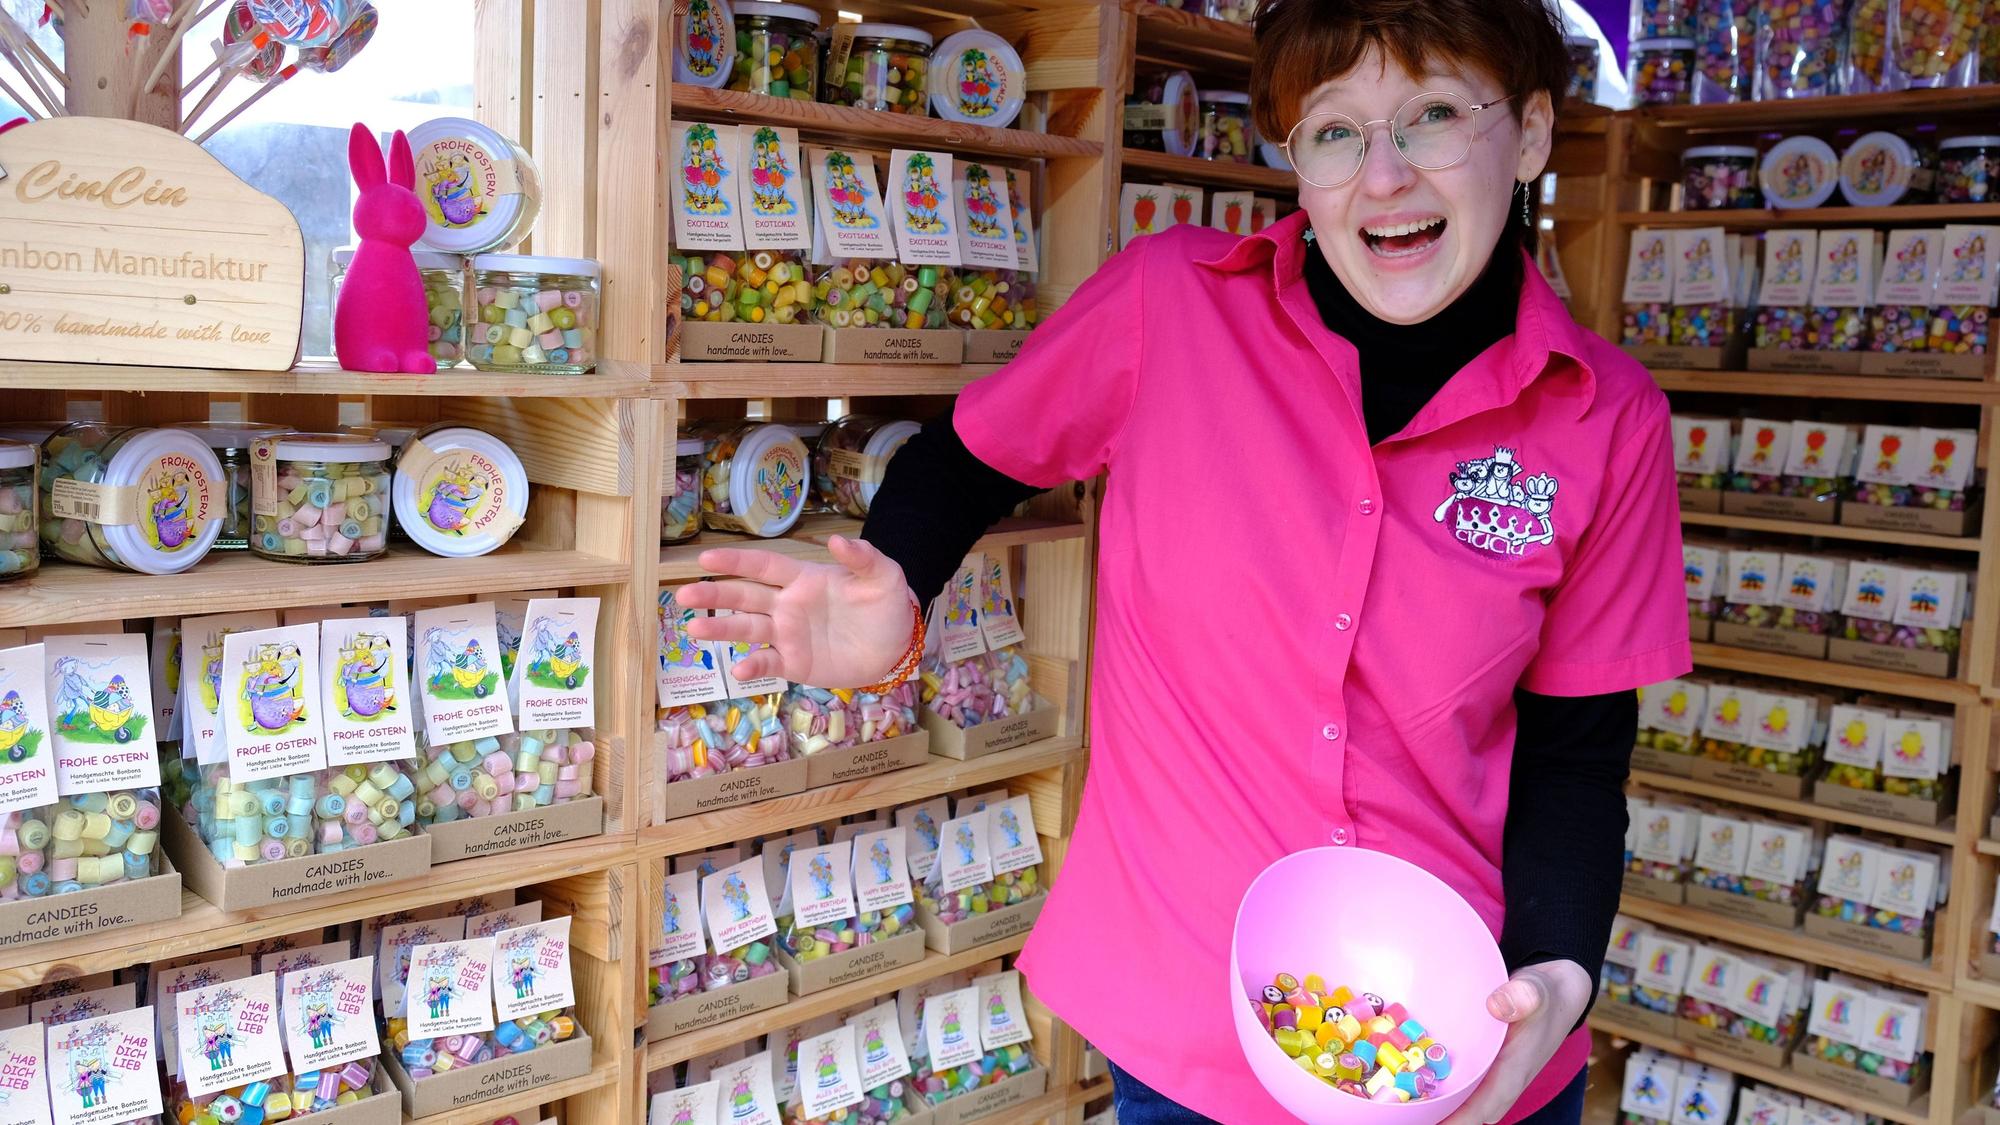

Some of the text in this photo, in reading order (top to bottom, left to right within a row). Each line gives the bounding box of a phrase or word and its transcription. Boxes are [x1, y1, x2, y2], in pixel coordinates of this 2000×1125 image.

[434, 140, 496, 198] FROHE OSTERN
[16, 160, 189, 209] CinCin
[687, 219, 729, 229] EXOTICMIX
[755, 220, 796, 228] EXOTICMIX
[909, 238, 948, 247] EXOTICMIX
[94, 247, 268, 282] Manufaktur
[54, 313, 168, 340] handmade
[177, 320, 222, 341] with
[231, 325, 272, 344] love
[731, 333, 774, 344] CANDIES
[885, 338, 921, 348] CANDIES
[706, 345, 749, 356] handmade
[751, 346, 770, 356] with
[863, 350, 901, 360] handmade
[902, 350, 918, 359] with
[161, 456, 209, 521] FROHE OSTERN
[470, 454, 503, 529] FROHE OSTERN
[526, 697, 588, 708] FROHE OSTERN
[433, 704, 503, 723] FROHE OSTERN
[333, 726, 407, 741] FROHE OSTERN
[236, 737, 317, 758] FROHE OSTERN
[59, 752, 149, 768] FROHE OSTERN
[246, 756, 287, 768] Handgemachte
[852, 750, 888, 764] CANDIES
[70, 771, 115, 780] Handgemachte
[832, 766, 869, 779] handmade
[870, 762, 886, 772] with
[720, 777, 761, 792] CANDIES
[697, 794, 739, 808] handmade
[740, 790, 757, 800] with
[494, 819, 544, 836] CANDIES
[464, 838, 517, 854] handmade
[519, 832, 541, 844] with
[305, 859, 365, 878] CANDIES
[272, 879, 335, 898] handmade
[336, 874, 361, 887] with
[27, 903, 98, 925] CANDIES
[64, 919, 93, 934] with
[546, 938, 564, 950] HAB
[665, 933, 697, 944] BIRTHDAY
[540, 947, 563, 959] DICH
[848, 951, 885, 968] CANDIES
[468, 959, 487, 972] HAB
[537, 957, 559, 969] LIEB
[460, 968, 485, 983] DICH
[829, 967, 865, 984] handmade
[867, 963, 882, 973] with
[345, 982, 367, 993] HAB
[457, 978, 479, 992] LIEB
[339, 992, 365, 1005] DICH
[698, 994, 740, 1014] CANDIES
[246, 1000, 270, 1012] HAB
[337, 1002, 361, 1015] LIEB
[239, 1011, 269, 1024] DICH
[674, 1013, 717, 1031] handmade
[719, 1009, 737, 1019] with
[237, 1022, 264, 1035] LIEB
[123, 1035, 148, 1047] HAB
[116, 1045, 147, 1059] DICH
[304, 1040, 367, 1060] Handgemachte Bonbons
[10, 1053, 37, 1066] HAB
[113, 1058, 141, 1071] LIEB
[2, 1064, 36, 1078] DICH
[200, 1060, 271, 1082] Handgemachte Bonbons
[481, 1064, 532, 1085] CANDIES
[0, 1076, 29, 1090] LIEB
[226, 1075, 241, 1083] Liebe
[452, 1083, 504, 1105] handmade
[507, 1077, 529, 1093] with
[70, 1099, 148, 1120] Handgemachte Bonbons
[98, 1112, 114, 1121] Liebe
